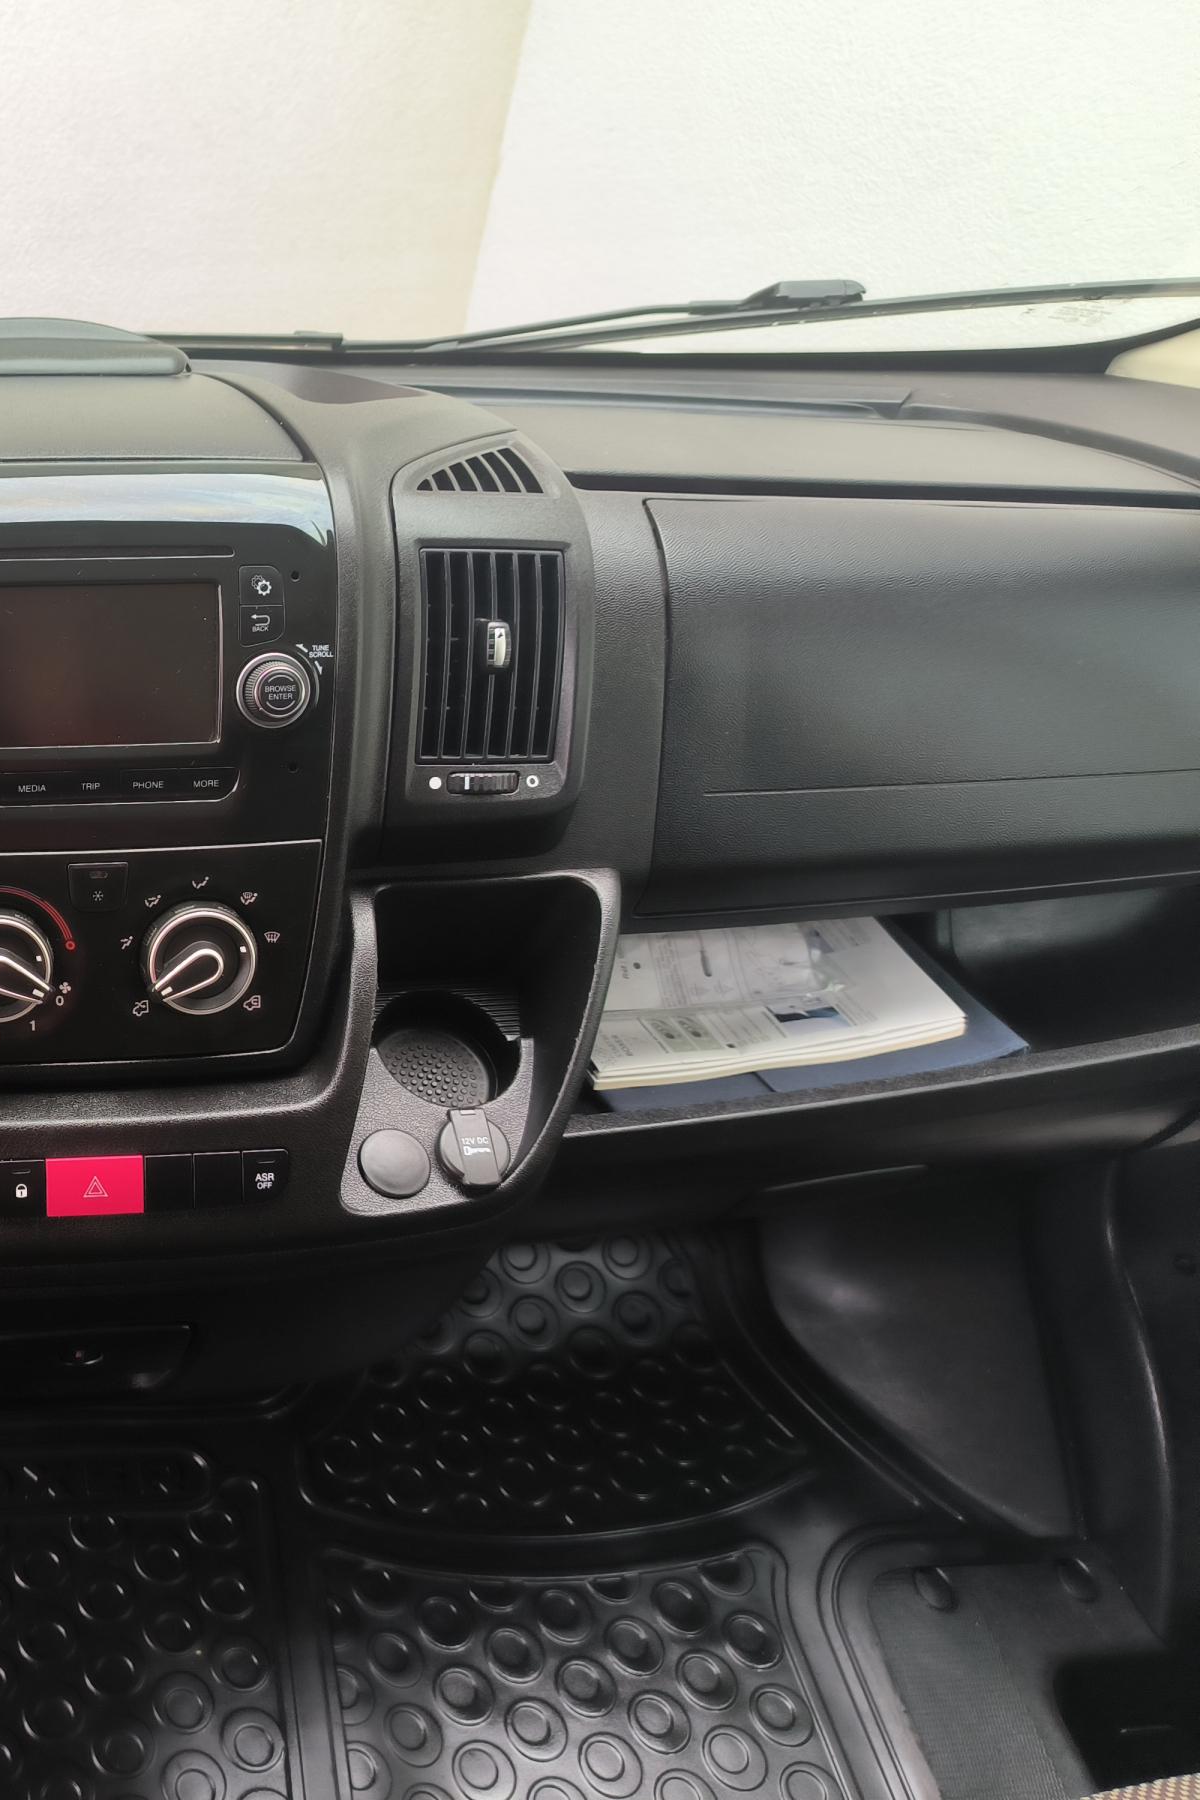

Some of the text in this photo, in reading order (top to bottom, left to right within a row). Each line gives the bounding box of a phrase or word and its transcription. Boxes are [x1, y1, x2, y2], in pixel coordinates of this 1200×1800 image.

[252, 625, 270, 633] BACK
[264, 684, 297, 693] BROWSE
[81, 782, 101, 791] TRIP
[132, 780, 165, 789] PHONE
[193, 779, 220, 788] MORE
[17, 784, 47, 793] MEDIA
[55, 995, 65, 1006] 0
[29, 1020, 36, 1031] 1
[461, 1136, 489, 1145] 12V DC
[255, 1172, 275, 1182] ASR
[256, 1181, 273, 1190] OFF
